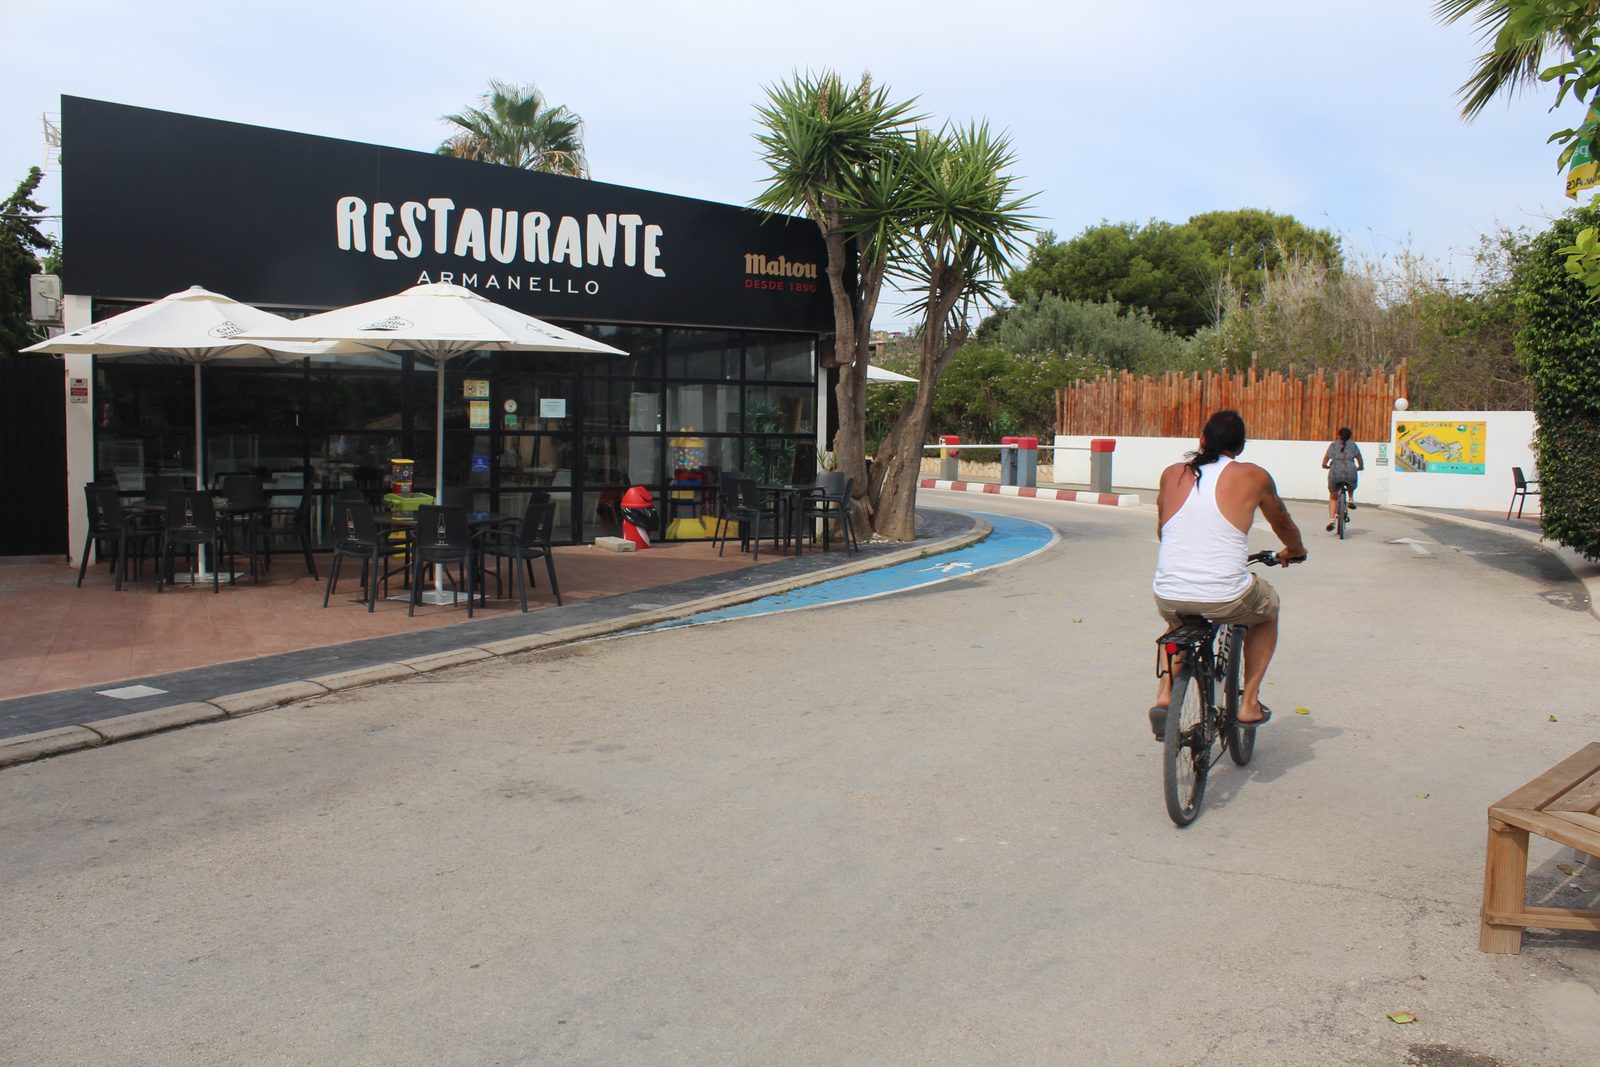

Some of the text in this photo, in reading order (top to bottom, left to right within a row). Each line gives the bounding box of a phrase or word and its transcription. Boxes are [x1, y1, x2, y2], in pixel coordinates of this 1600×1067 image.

[336, 196, 666, 277] RESTAURANTE
[744, 253, 818, 279] Mahou
[416, 270, 600, 295] ARMANELLO
[745, 280, 817, 293] DESDE 1890
